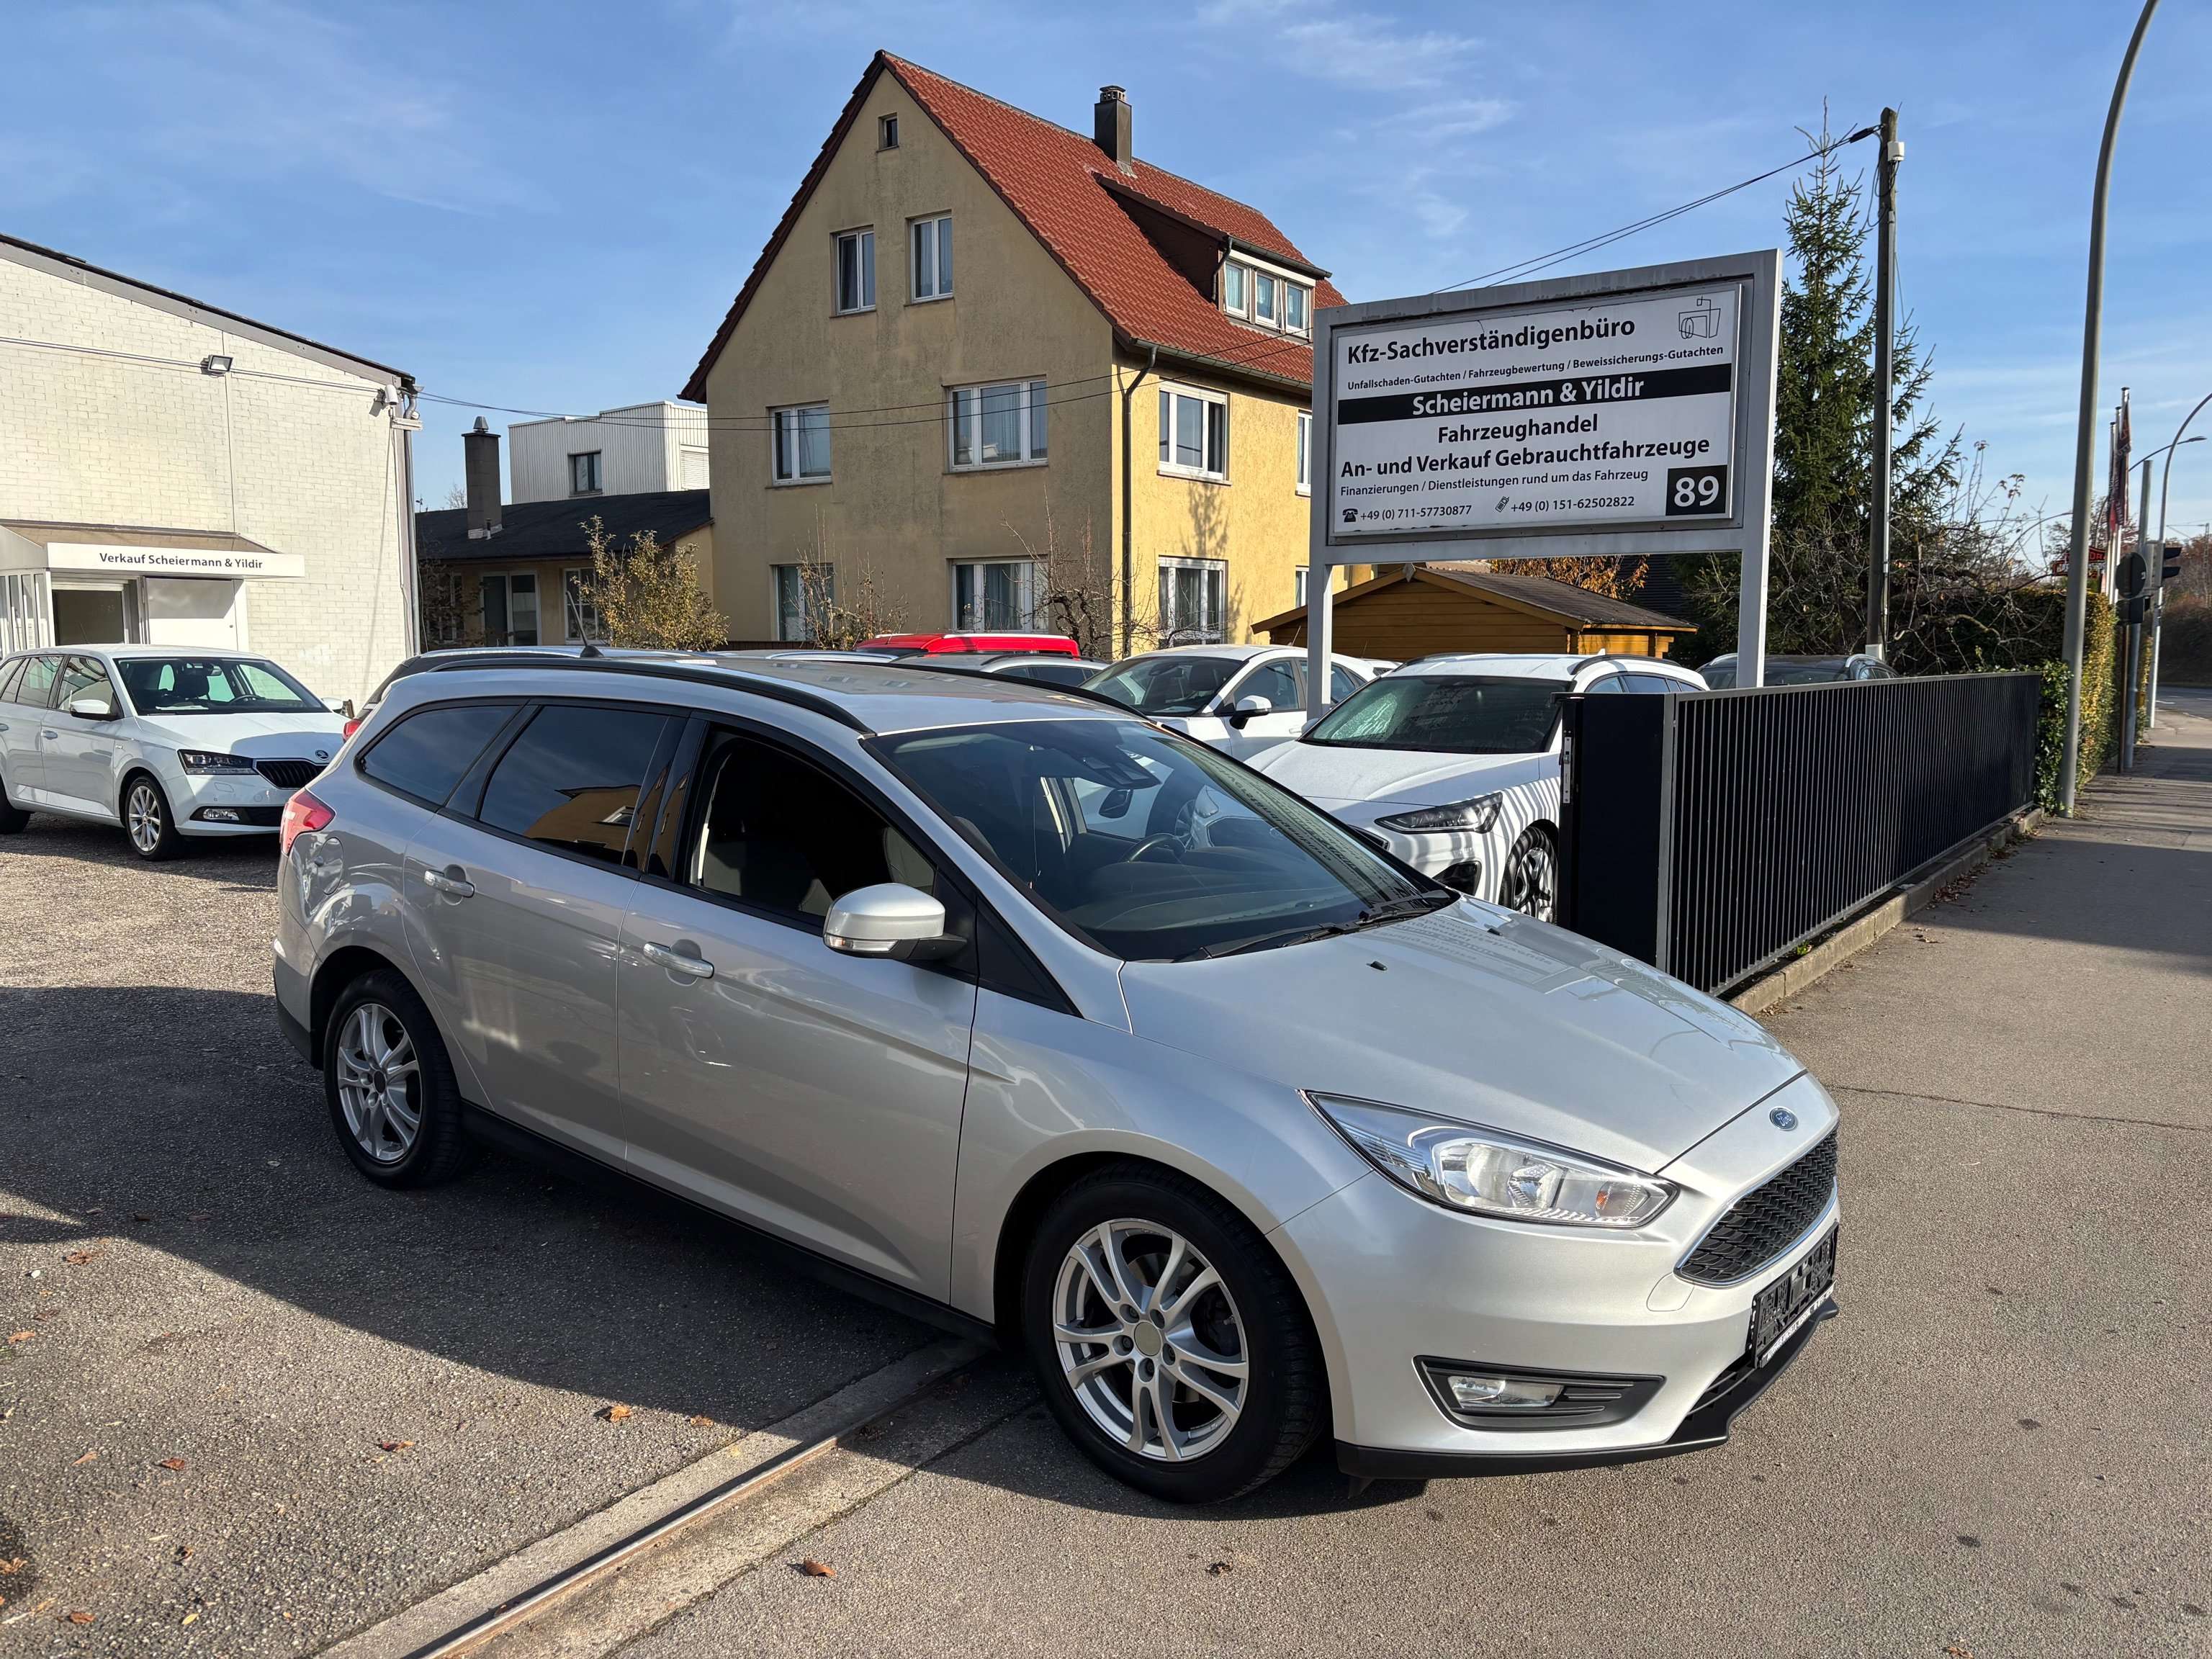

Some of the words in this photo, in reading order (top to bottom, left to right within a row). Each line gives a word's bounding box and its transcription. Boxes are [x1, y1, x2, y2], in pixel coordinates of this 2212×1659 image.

[1348, 318, 1635, 364] Kfz-Sachverständigenbüro
[1348, 371, 1461, 390] Unfallschaden-Gutachten
[1468, 362, 1565, 379] Fahrzeugbewertung
[1573, 346, 1724, 369] Beweissicherungs-Gutachten
[1412, 388, 1553, 415] Scheiermann
[1560, 382, 1577, 403] &
[1581, 376, 1645, 400] Yildir
[1438, 413, 1598, 444] Fahrzeughandel
[1341, 462, 1372, 477] An-
[1377, 456, 1412, 475] und
[1416, 450, 1492, 472] Verkauf
[1496, 439, 1710, 467] Gebrauchtfahrzeuge
[1341, 483, 1419, 496] Finanzierungen
[1429, 477, 1519, 490] Dienstleistungen
[1521, 473, 1548, 485] rund
[1551, 473, 1569, 482] um
[1572, 471, 1591, 482] das
[1594, 469, 1648, 482] Fahrzeug
[1673, 475, 1719, 507] 89
[1360, 509, 1379, 520] +49
[1382, 508, 1395, 521] (0)
[1398, 505, 1472, 518] 711-57730877
[1511, 500, 1532, 512] +49
[1535, 499, 1549, 512] (0)
[1552, 496, 1635, 511] 151-62502822
[99, 552, 145, 564] Verkauf
[148, 554, 222, 567] Scheiermann
[225, 558, 233, 567] &
[235, 559, 263, 569] Yildir
